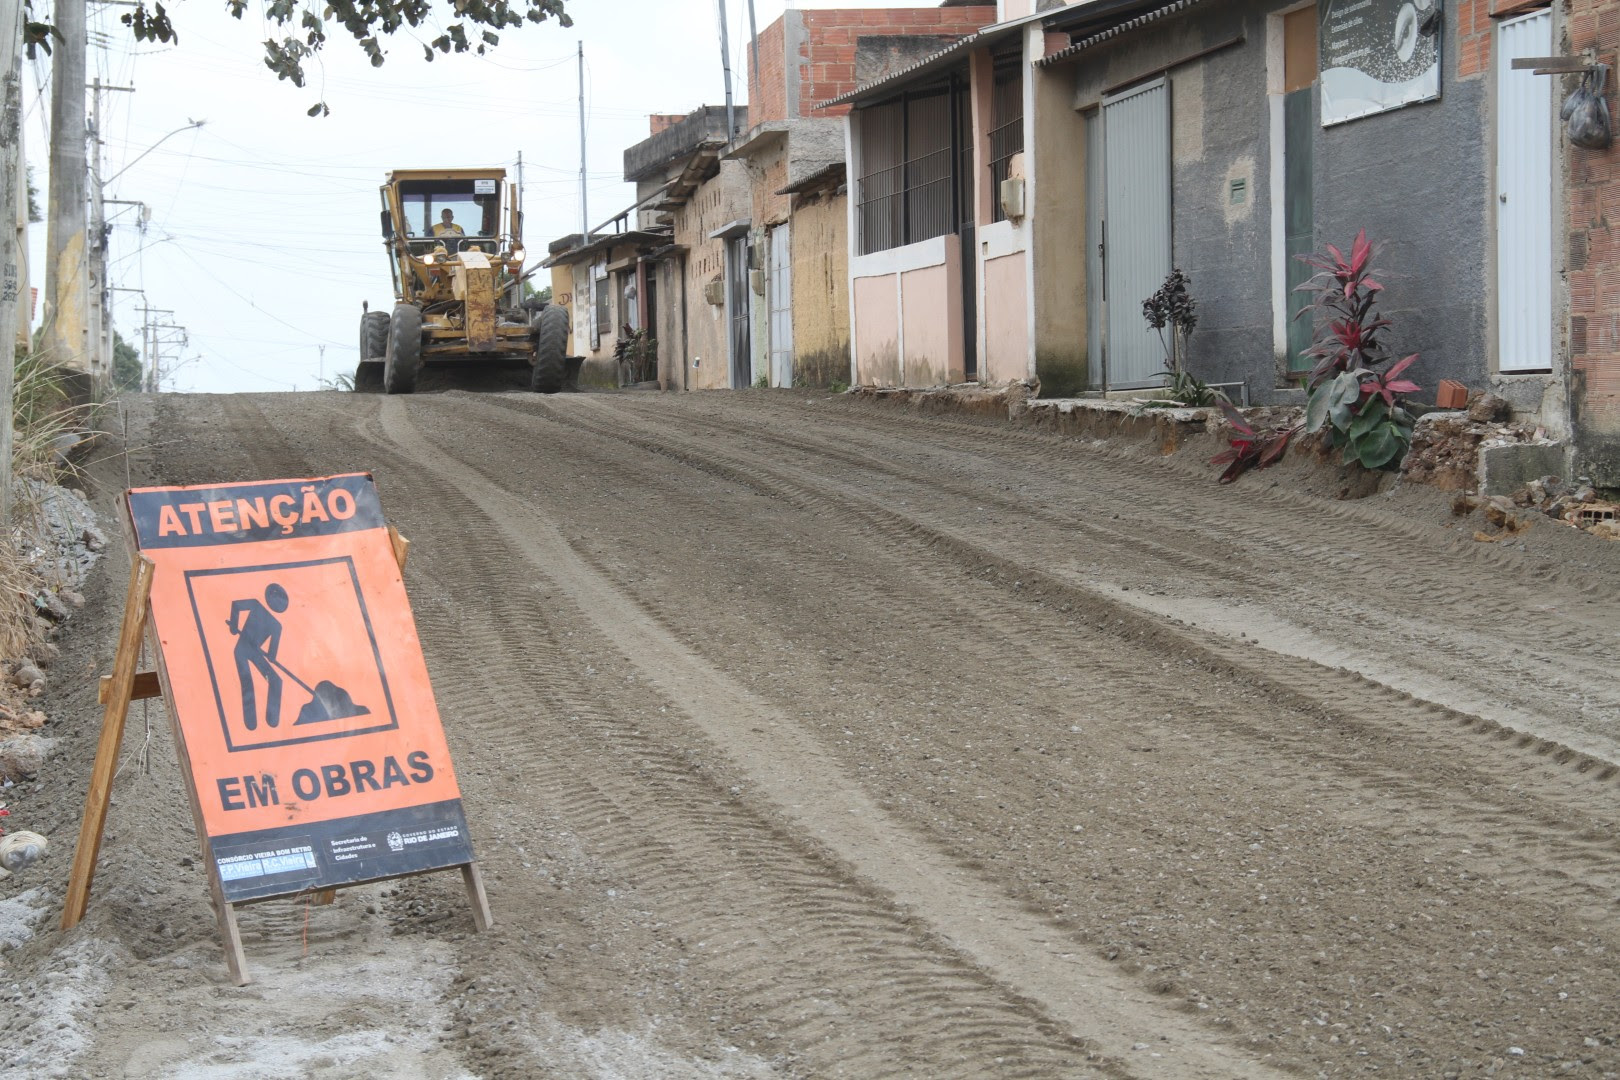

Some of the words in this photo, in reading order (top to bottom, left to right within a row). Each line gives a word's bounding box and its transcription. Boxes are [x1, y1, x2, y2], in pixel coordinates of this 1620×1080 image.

[158, 486, 356, 537] ATENÇÃO
[216, 773, 280, 811] EM
[291, 750, 434, 801] OBRAS
[404, 836, 418, 845] RIO
[417, 835, 428, 843] DE
[428, 830, 459, 841] JANEIRO
[254, 851, 276, 860] VIEIRA
[276, 848, 291, 856] BOM
[335, 853, 358, 861] Cidades
